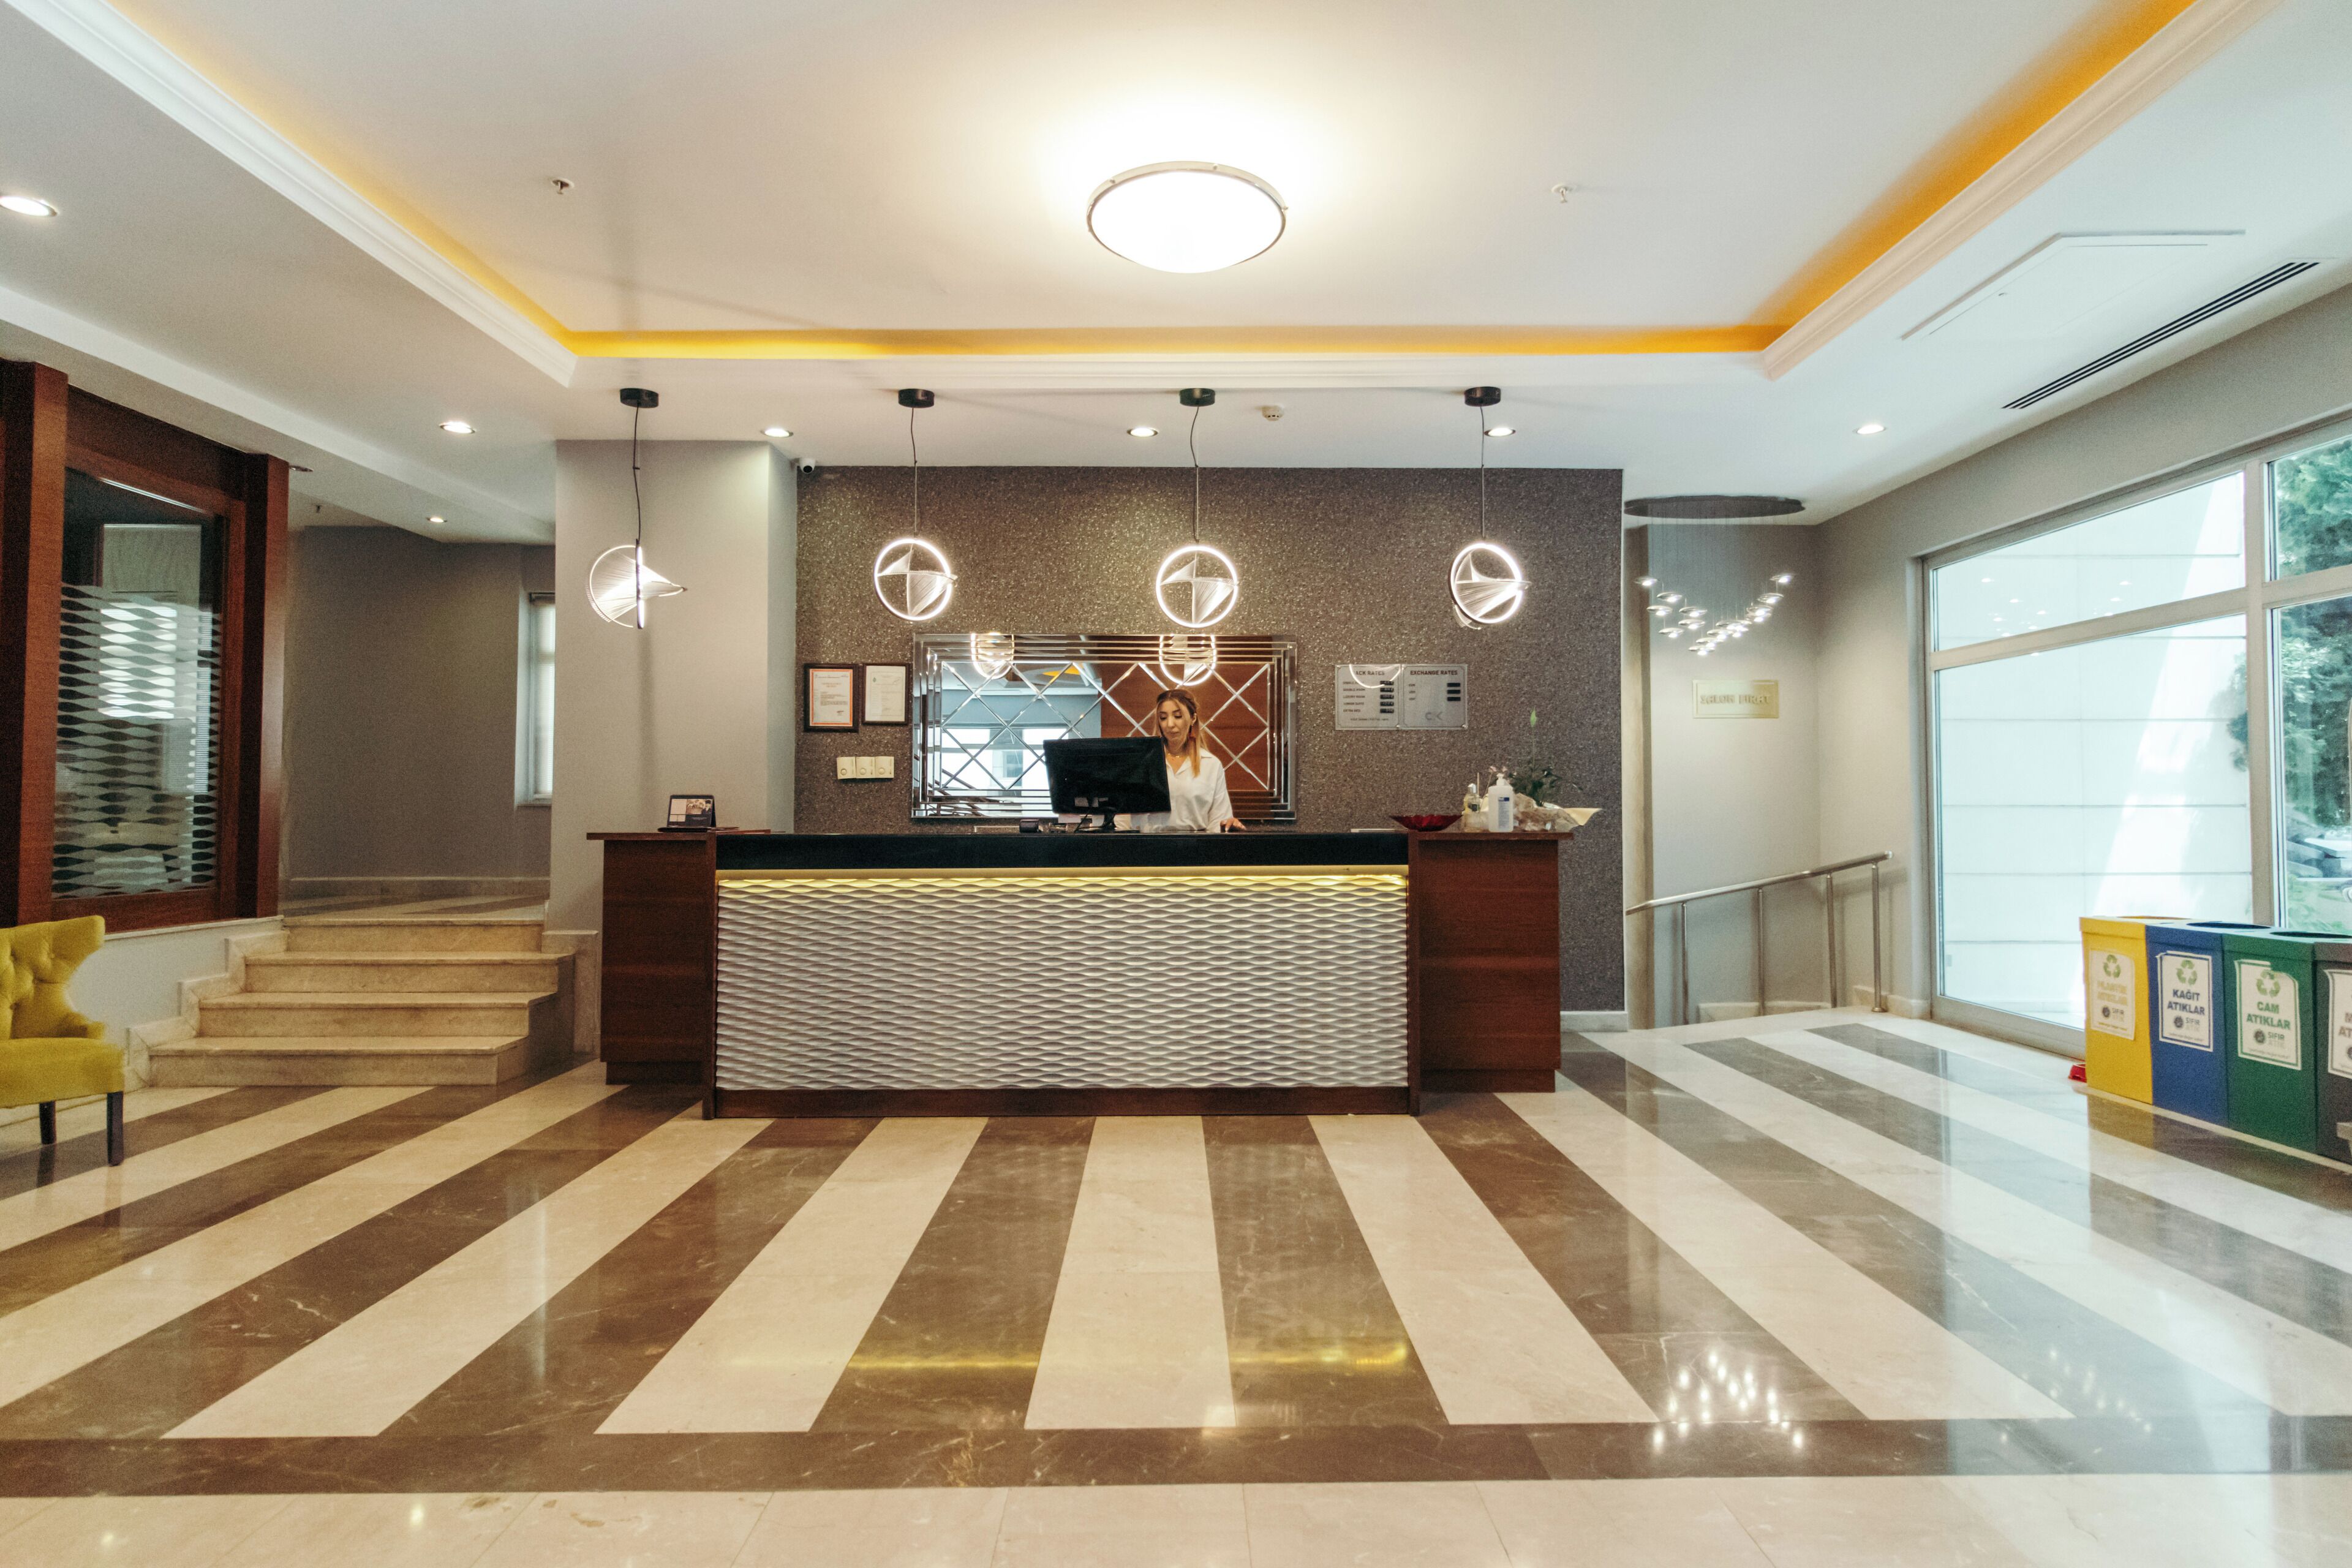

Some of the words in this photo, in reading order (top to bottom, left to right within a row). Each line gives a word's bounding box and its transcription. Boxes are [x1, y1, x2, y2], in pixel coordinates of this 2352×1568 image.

[2172, 989, 2201, 1001] KAĞIT
[2166, 1001, 2206, 1016] ATIKLAR
[2256, 1001, 2280, 1014] CAM
[2185, 1017, 2201, 1026] SIFIR
[2246, 1013, 2291, 1031] ATIKLAR
[2267, 1031, 2285, 1041] SIFIR
